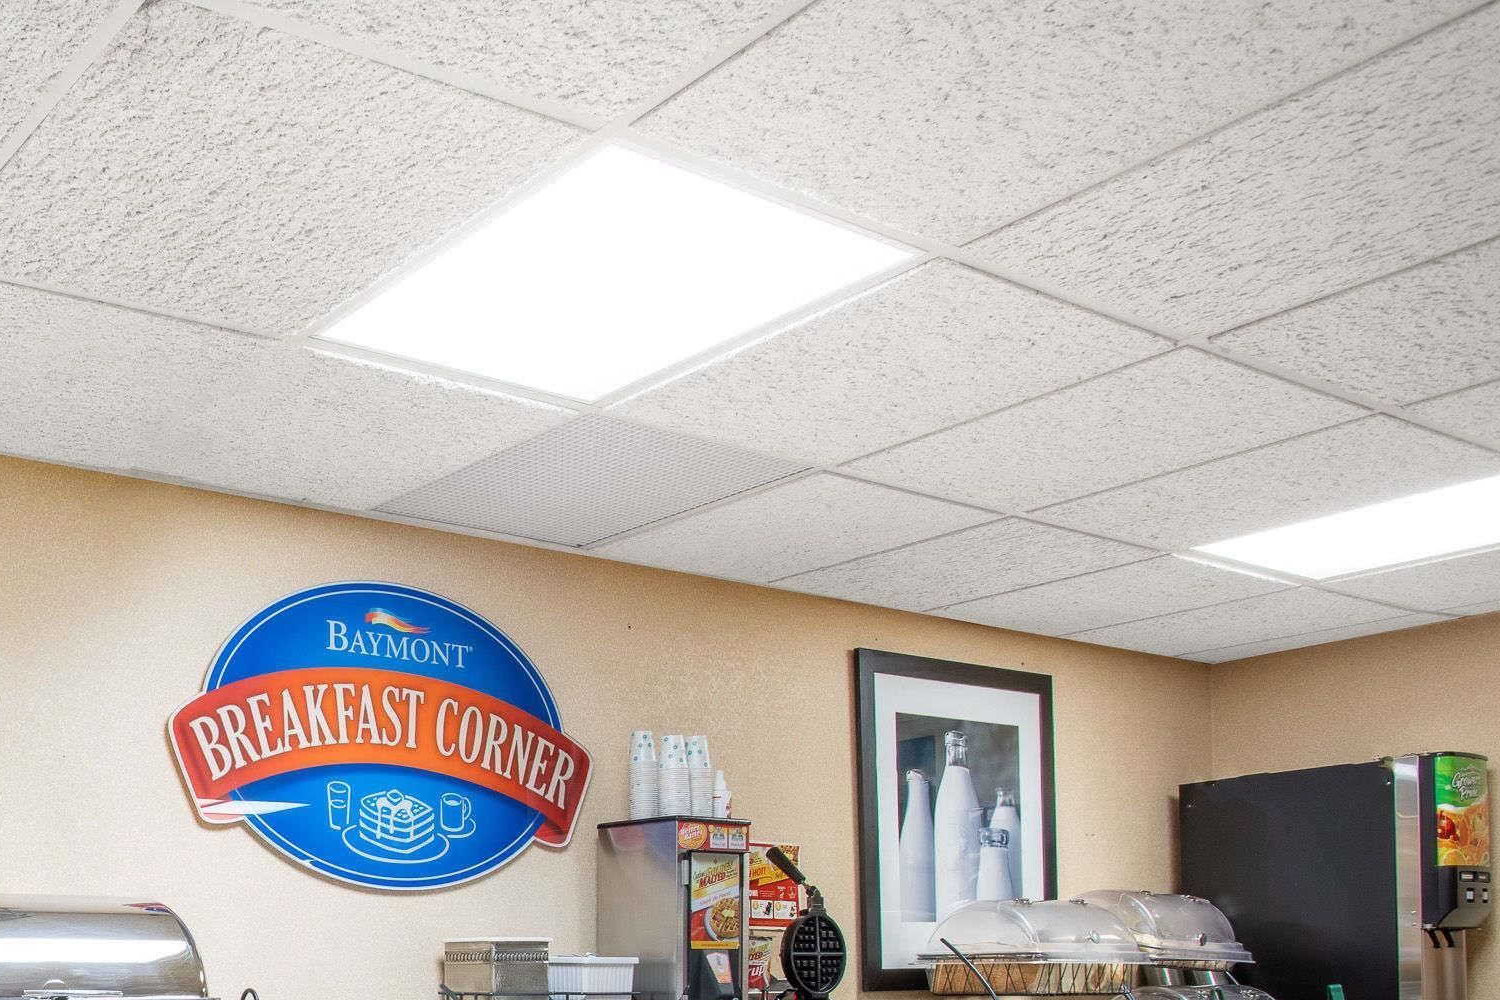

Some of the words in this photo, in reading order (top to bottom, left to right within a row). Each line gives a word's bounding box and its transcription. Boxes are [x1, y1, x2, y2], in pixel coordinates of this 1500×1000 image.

[325, 619, 469, 669] BAYMONT
[189, 683, 425, 782] BREAKFAST
[435, 695, 576, 811] CORNER
